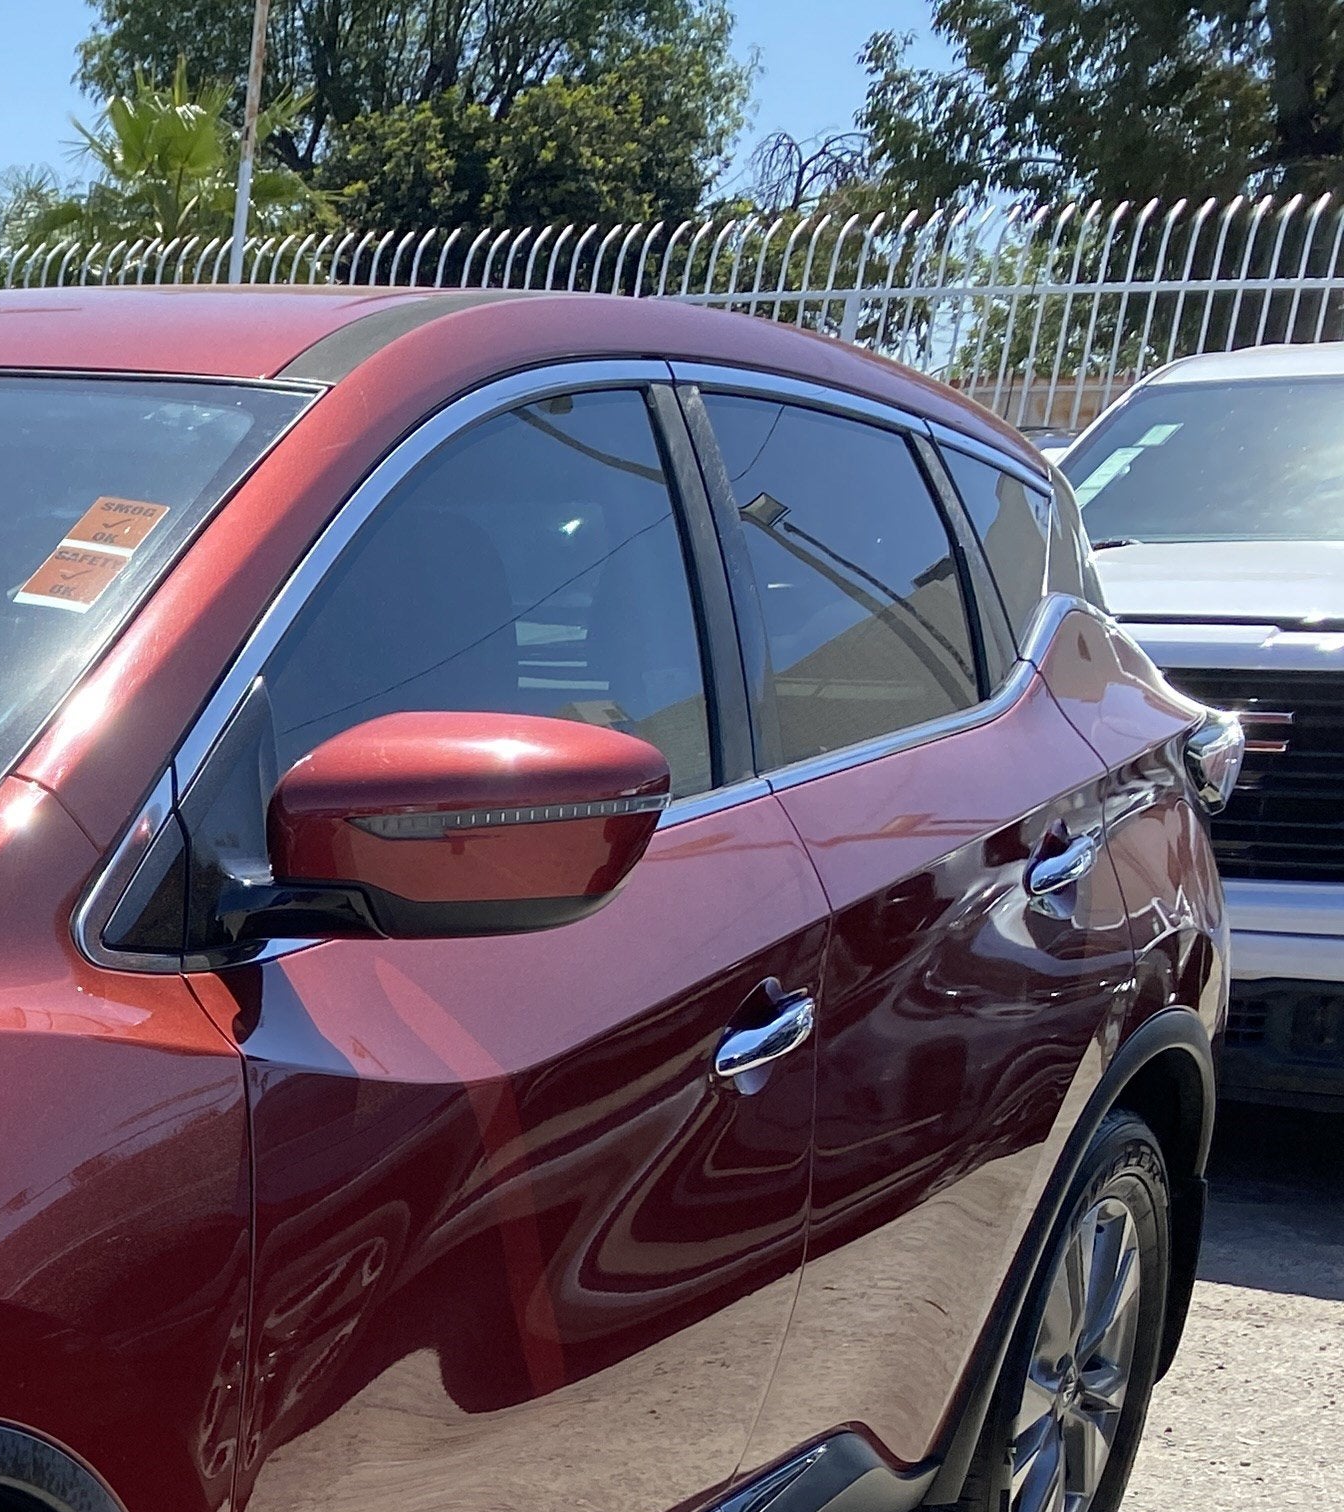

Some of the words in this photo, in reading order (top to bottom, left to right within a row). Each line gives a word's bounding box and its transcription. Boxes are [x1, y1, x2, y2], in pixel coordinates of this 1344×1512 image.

[101, 503, 158, 517] SMOG
[92, 532, 119, 543] OK
[55, 551, 125, 569] SAFETY
[49, 584, 77, 596] OK
